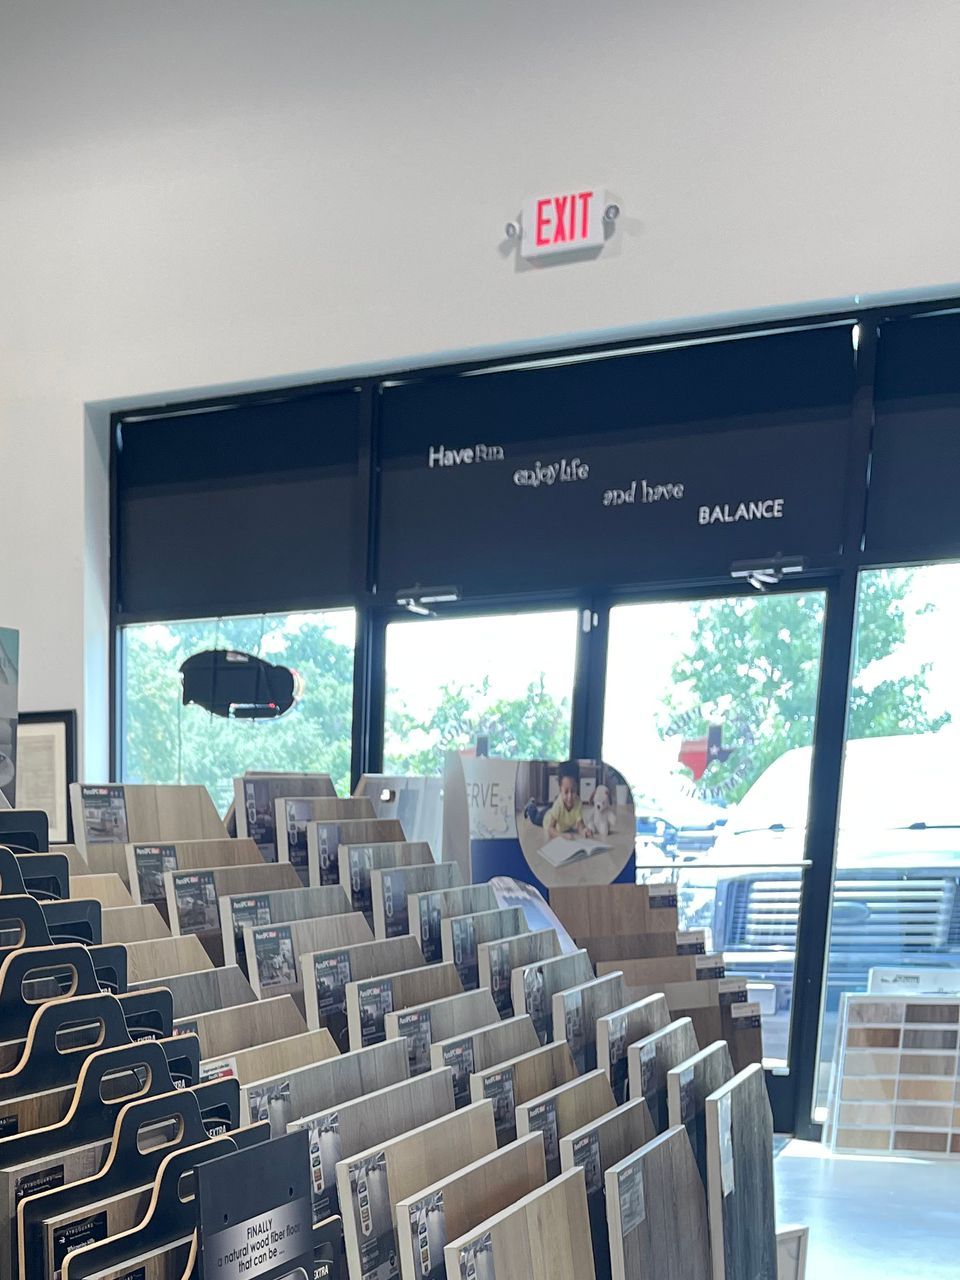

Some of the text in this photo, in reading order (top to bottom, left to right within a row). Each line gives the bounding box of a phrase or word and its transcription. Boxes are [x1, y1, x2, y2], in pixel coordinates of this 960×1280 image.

[536, 192, 593, 247] EXIT
[429, 445, 474, 468] Have
[602, 480, 637, 506] and
[698, 499, 784, 525] BALANCE
[247, 1218, 273, 1240] FINALLY
[217, 1223, 303, 1267] a natural wood fiber floor
[238, 1255, 252, 1273] that
[253, 1252, 268, 1266] can
[268, 1247, 278, 1260] be
